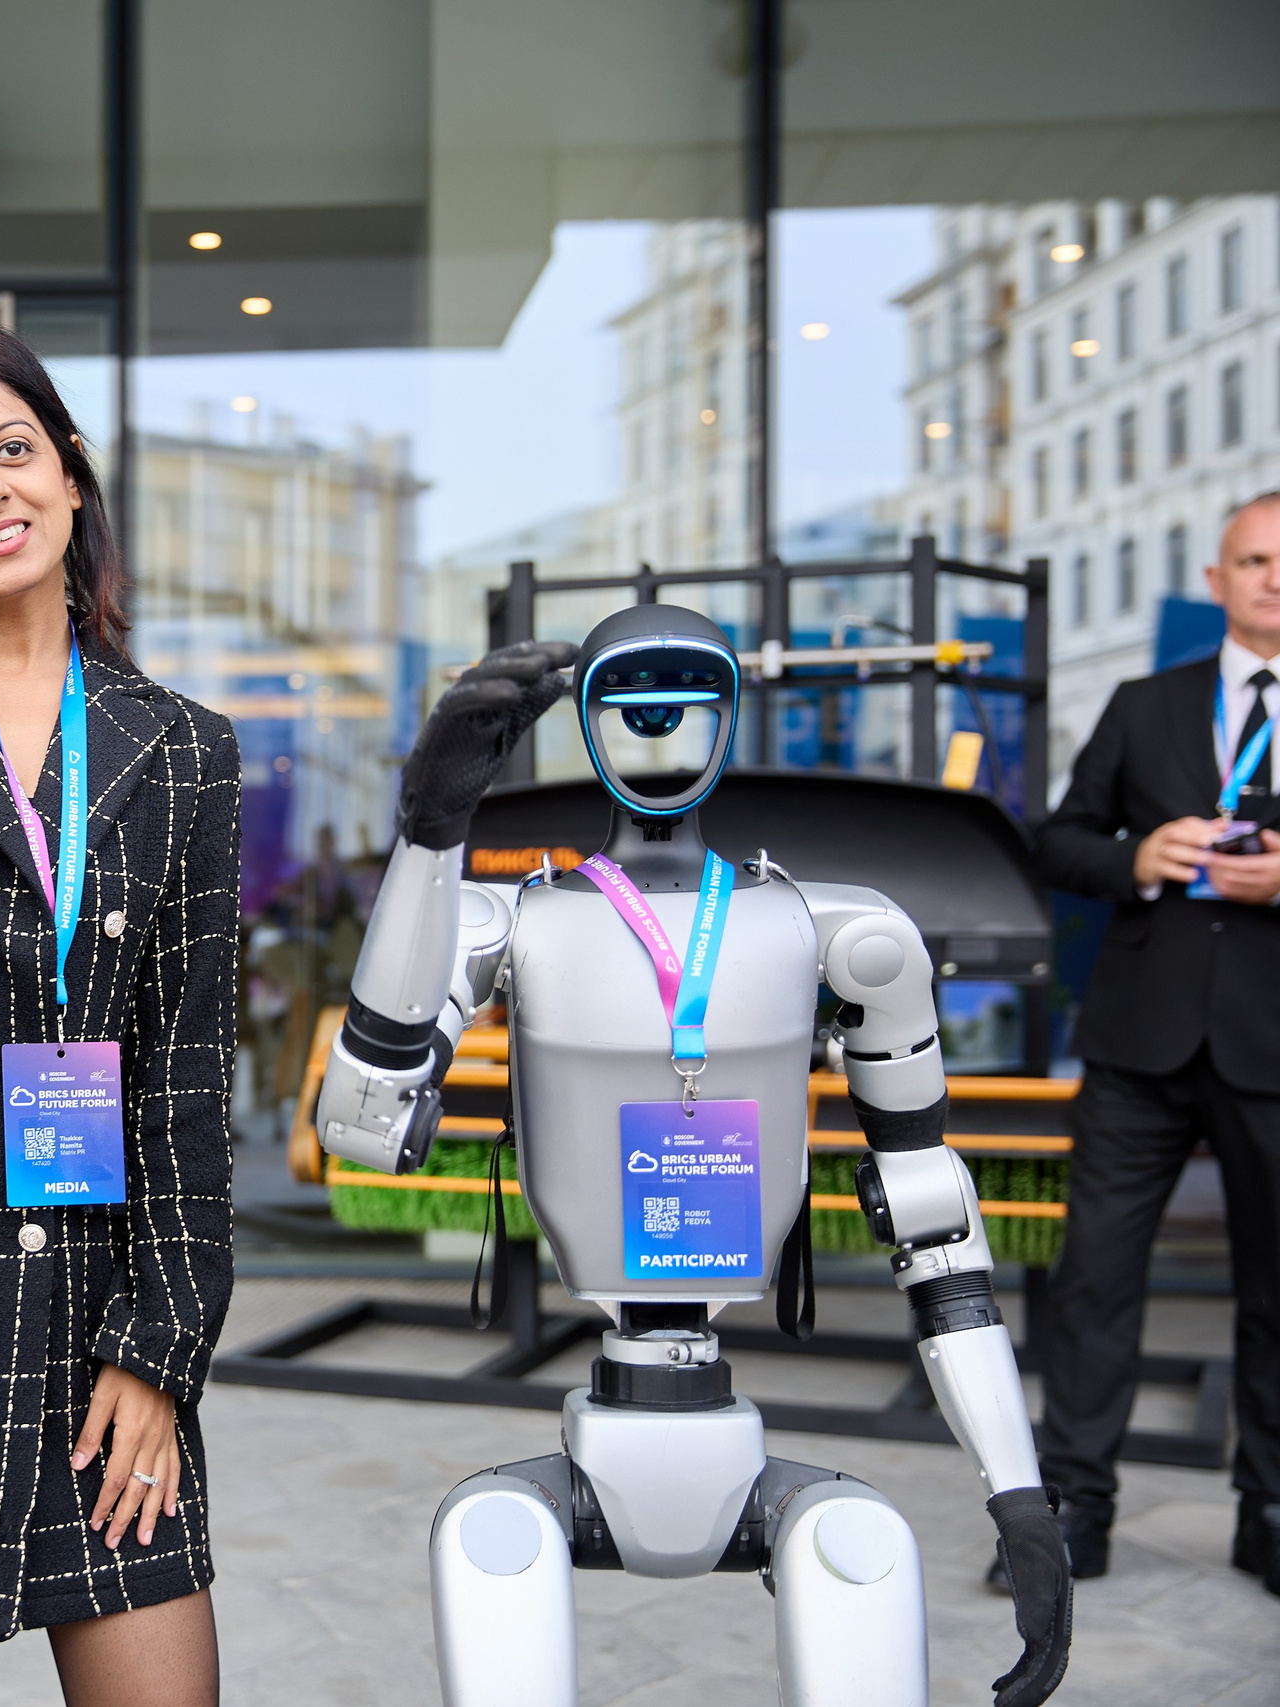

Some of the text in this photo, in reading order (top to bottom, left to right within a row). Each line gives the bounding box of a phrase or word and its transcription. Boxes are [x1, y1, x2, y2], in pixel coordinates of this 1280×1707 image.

[27, 827, 43, 867] URBAN
[61, 767, 79, 929] BRICS URBAN FUTURE FORUM
[709, 861, 723, 888] URBAN
[591, 858, 669, 951] BRICS URBAN FUTURE
[700, 888, 720, 931] FUTURE
[690, 933, 710, 977] FORUM
[38, 1088, 106, 1099] BRICS URBAN
[38, 1098, 117, 1109] FUTURE FORUM
[661, 1153, 741, 1164] BRICS URBAN
[661, 1164, 754, 1176] FUTURE FORUM
[44, 1181, 90, 1194] MEDIA
[684, 1217, 711, 1225] FEDYA
[640, 1253, 748, 1268] PARTICIPANT
